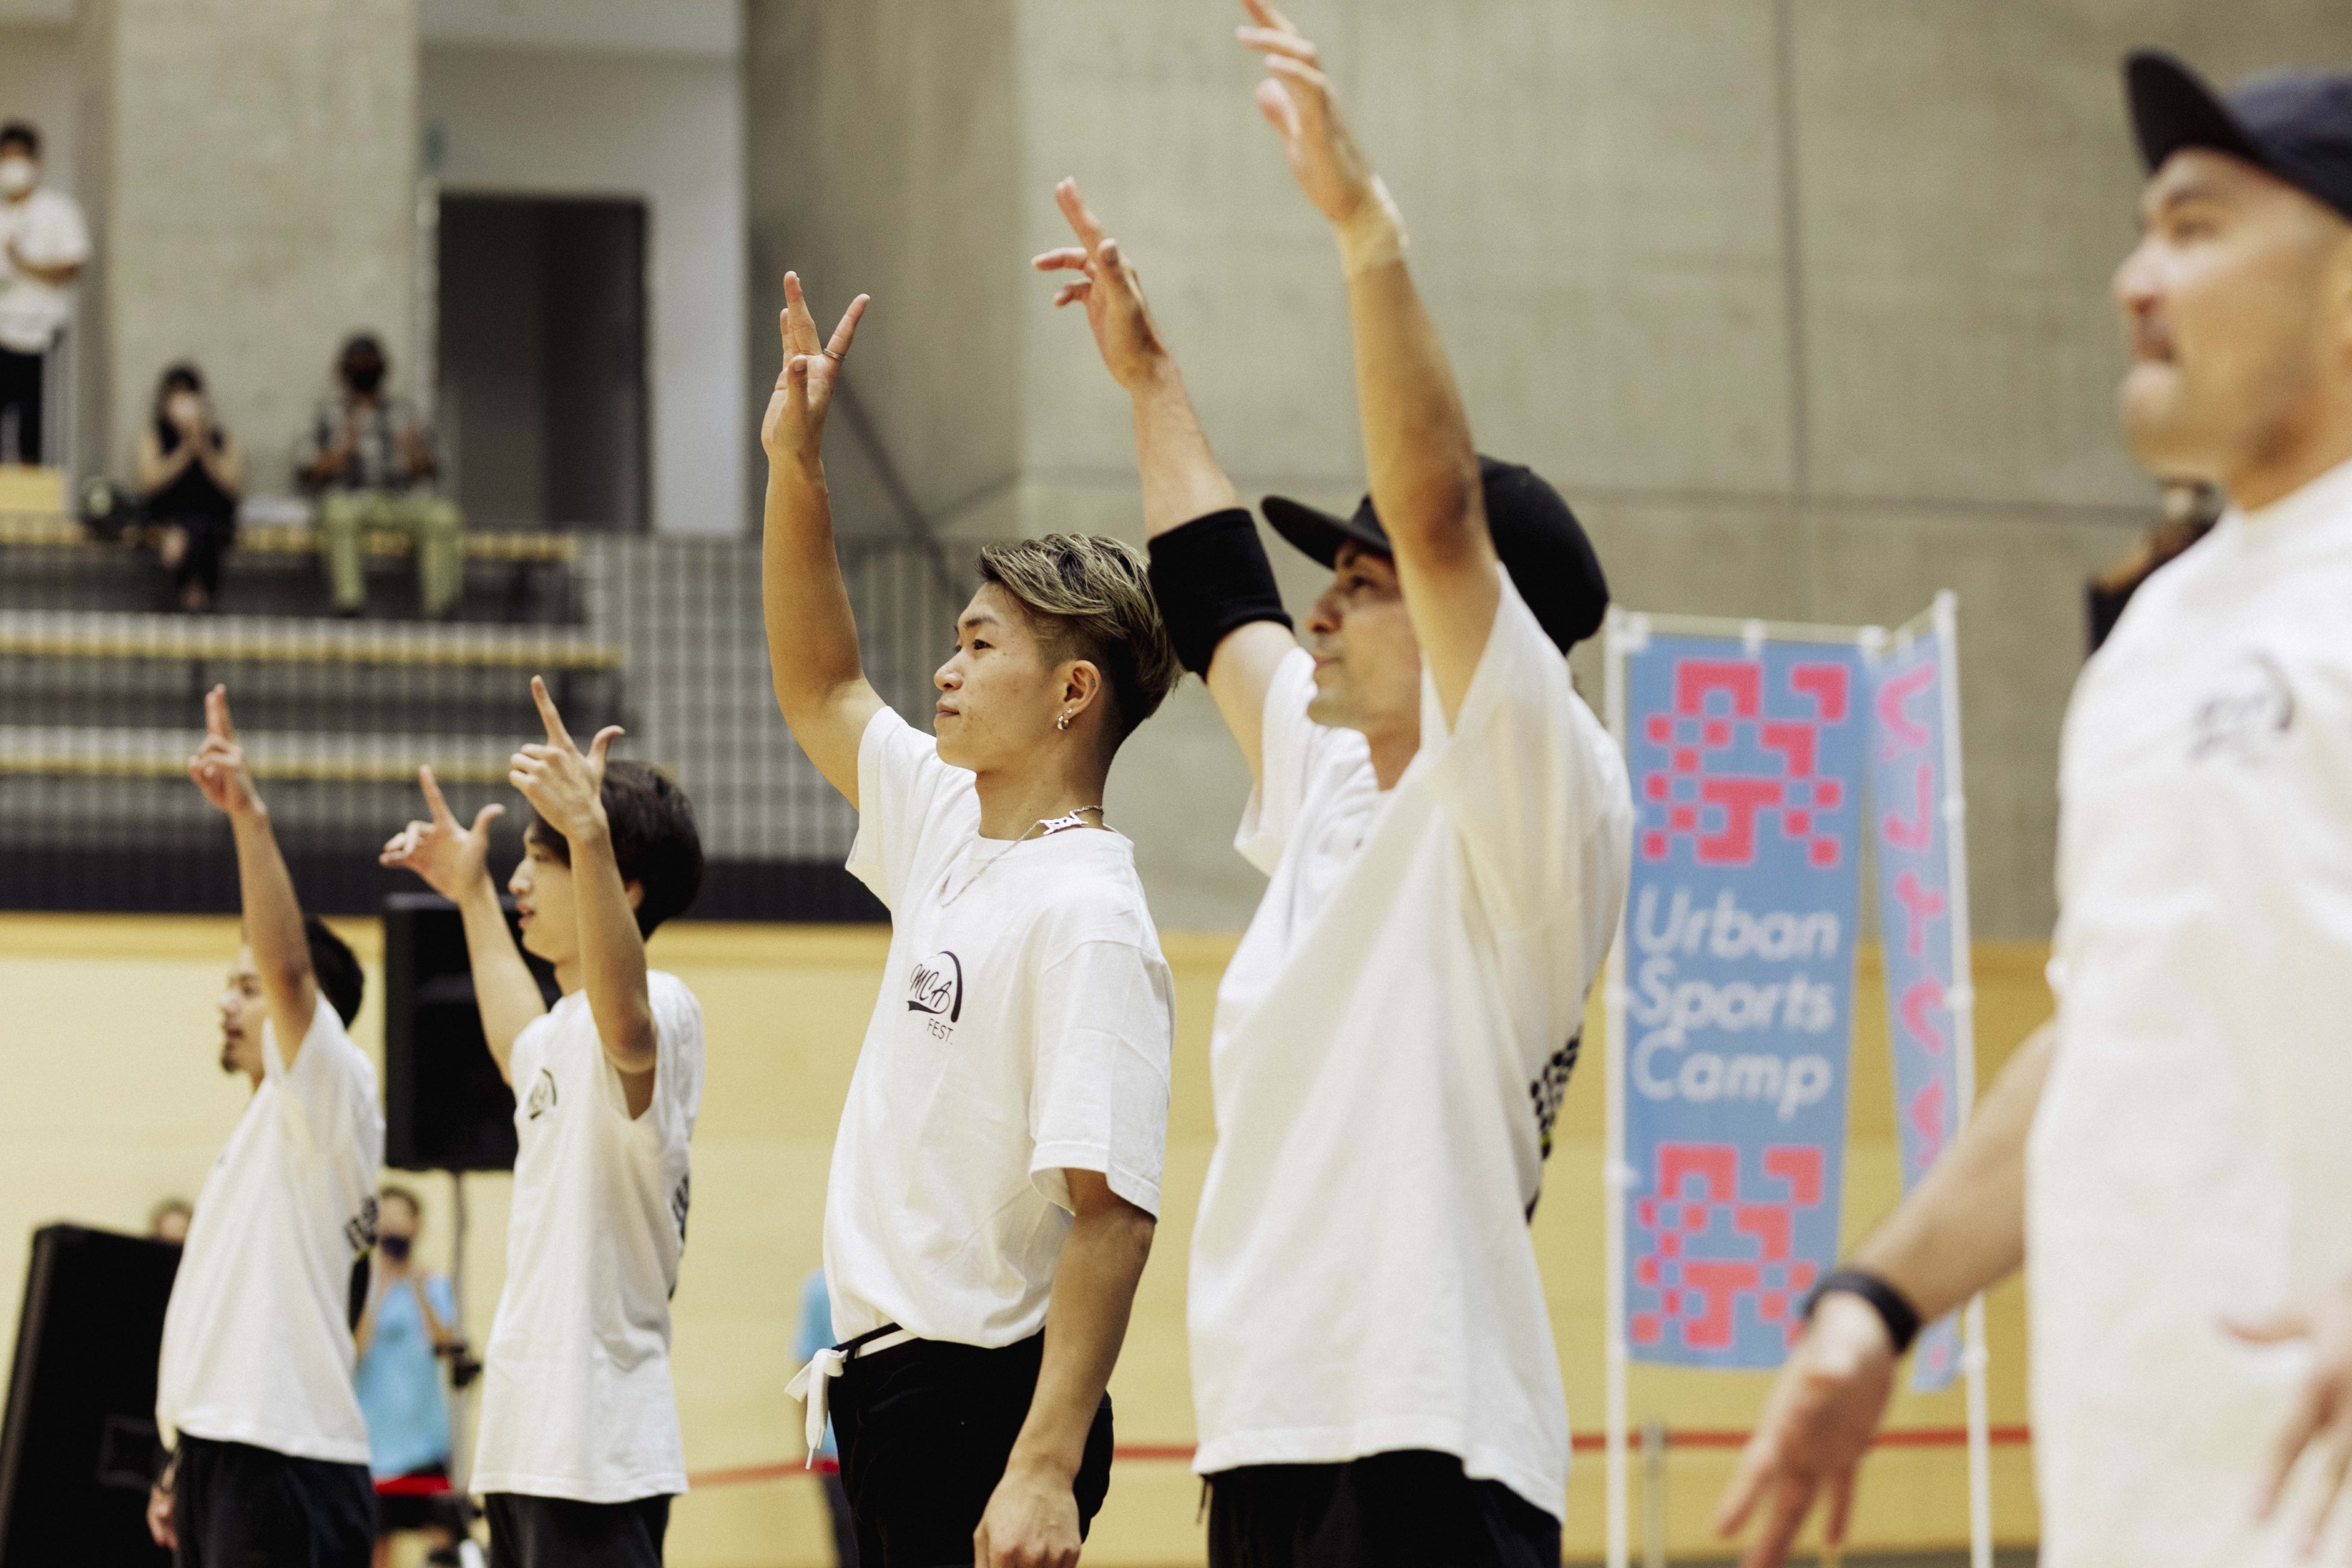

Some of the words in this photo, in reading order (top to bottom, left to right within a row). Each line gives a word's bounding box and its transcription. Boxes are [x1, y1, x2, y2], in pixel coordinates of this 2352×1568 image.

[1635, 885, 1841, 960] Urban
[1630, 956, 1836, 1048] Sports
[1632, 1027, 1833, 1123] Camp
